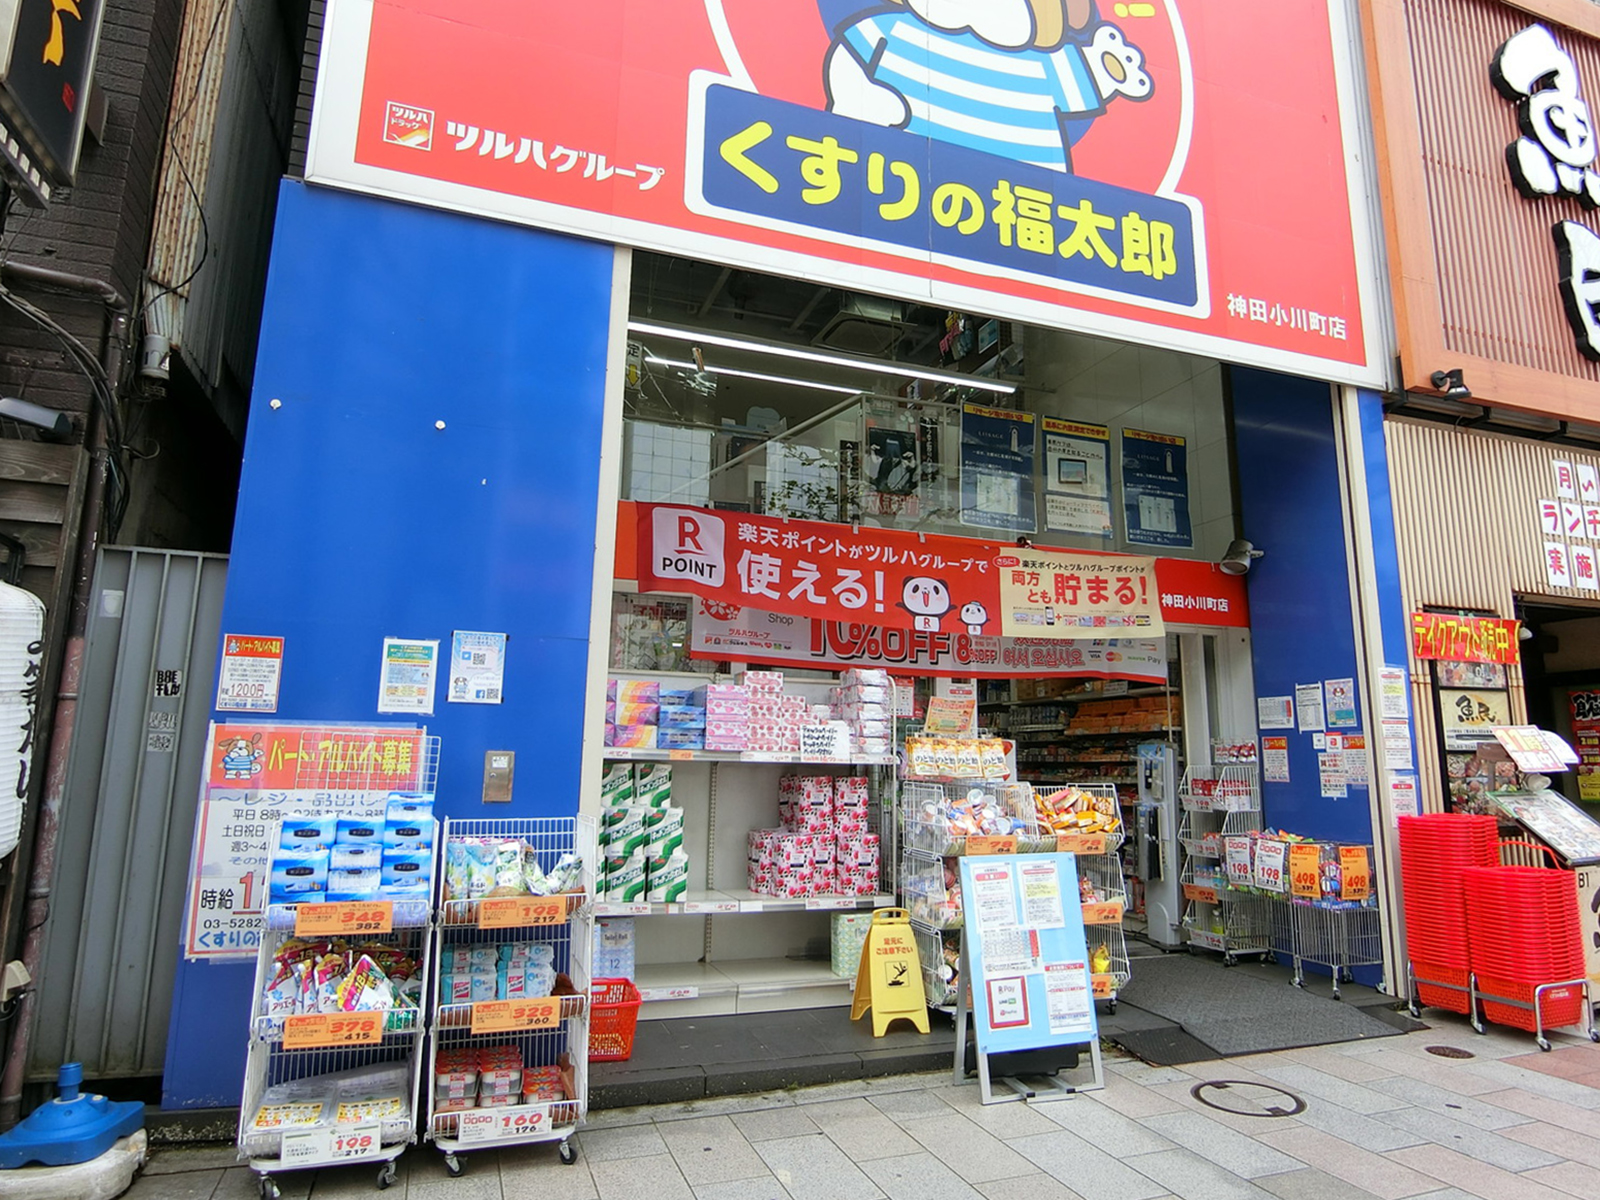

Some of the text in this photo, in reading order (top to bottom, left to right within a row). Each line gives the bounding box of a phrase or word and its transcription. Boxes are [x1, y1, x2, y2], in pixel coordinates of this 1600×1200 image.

[392, 105, 429, 124] ツルハ
[391, 117, 422, 130] ドラッグ
[447, 121, 665, 190] ツルハグループ
[719, 121, 1178, 281] くすりの福太郎
[1227, 293, 1346, 340] 神田小川町店
[738, 522, 989, 573] 楽天ポイントがツルハグループで
[662, 557, 717, 579] POINT
[1022, 560, 1146, 573] 楽天ポイントとツルハグループポイントが
[1547, 547, 1594, 579] 実施
[737, 549, 885, 613] 使える!
[1011, 569, 1041, 587] 両方
[1027, 588, 1052, 604] とも
[1053, 573, 1149, 606] 貯まる!
[1161, 593, 1228, 613] 神田小川町店
[768, 613, 794, 627] Shop
[728, 627, 771, 638] ツルハグループ
[1003, 647, 1030, 668] 어서
[1147, 655, 1162, 666] Pay
[268, 738, 413, 777] パート・アルバイト募集
[233, 808, 256, 821] 平日
[222, 824, 265, 838] 土日祝日
[231, 841, 269, 852] 週3～4
[1232, 863, 1249, 875] 198
[1261, 867, 1280, 881] 198
[1295, 872, 1316, 886] 498
[1347, 875, 1367, 888] 498
[1578, 872, 1590, 888] B1
[201, 871, 265, 909] 時給 1
[341, 911, 386, 923] 348
[522, 905, 560, 917] 198
[355, 921, 381, 931] 382
[533, 916, 556, 924] 217
[610, 958, 621, 969] 12
[513, 1006, 553, 1019] 328
[330, 1020, 375, 1033] 378
[526, 1017, 550, 1026] 360
[344, 1032, 371, 1041] 415
[501, 1112, 543, 1128] 160
[514, 1125, 537, 1133] 176
[335, 1135, 372, 1150] 198
[344, 1147, 368, 1157] 217
